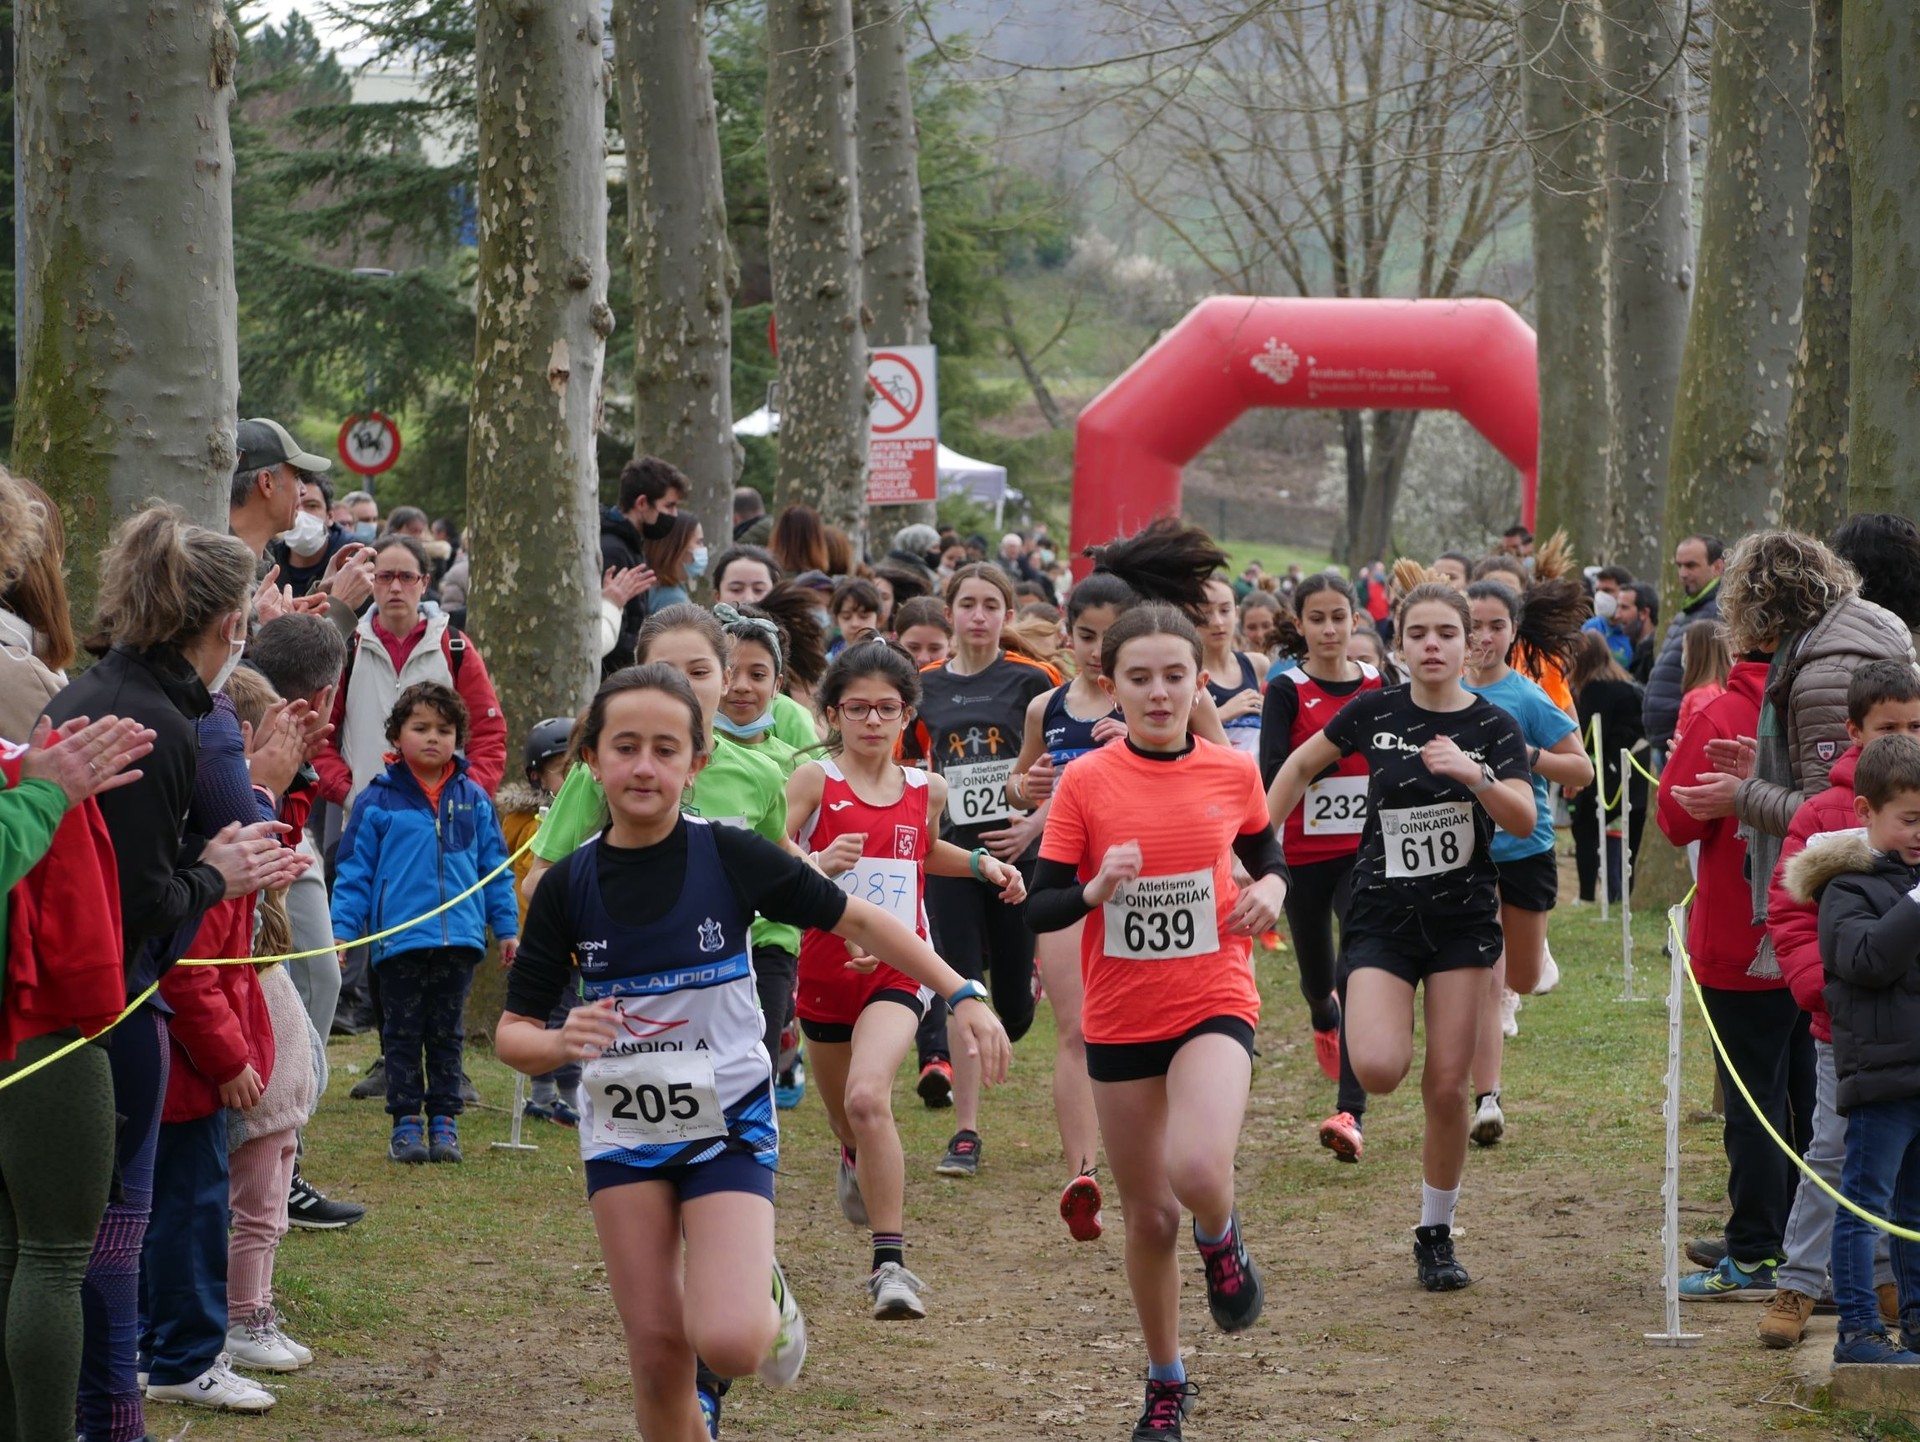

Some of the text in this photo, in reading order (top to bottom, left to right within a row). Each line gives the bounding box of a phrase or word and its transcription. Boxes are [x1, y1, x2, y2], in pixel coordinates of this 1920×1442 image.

[970, 764, 1009, 775] Atletismo
[963, 785, 1009, 818] 624
[1315, 794, 1368, 820] 232
[1409, 806, 1456, 821] Atletismo
[1400, 813, 1470, 834] OINKARIAK
[1401, 831, 1460, 871] 618
[1125, 886, 1210, 908] OINKARIAK
[1137, 879, 1196, 893] Atletismo
[1124, 908, 1195, 952] 639
[604, 1082, 700, 1124] 205
